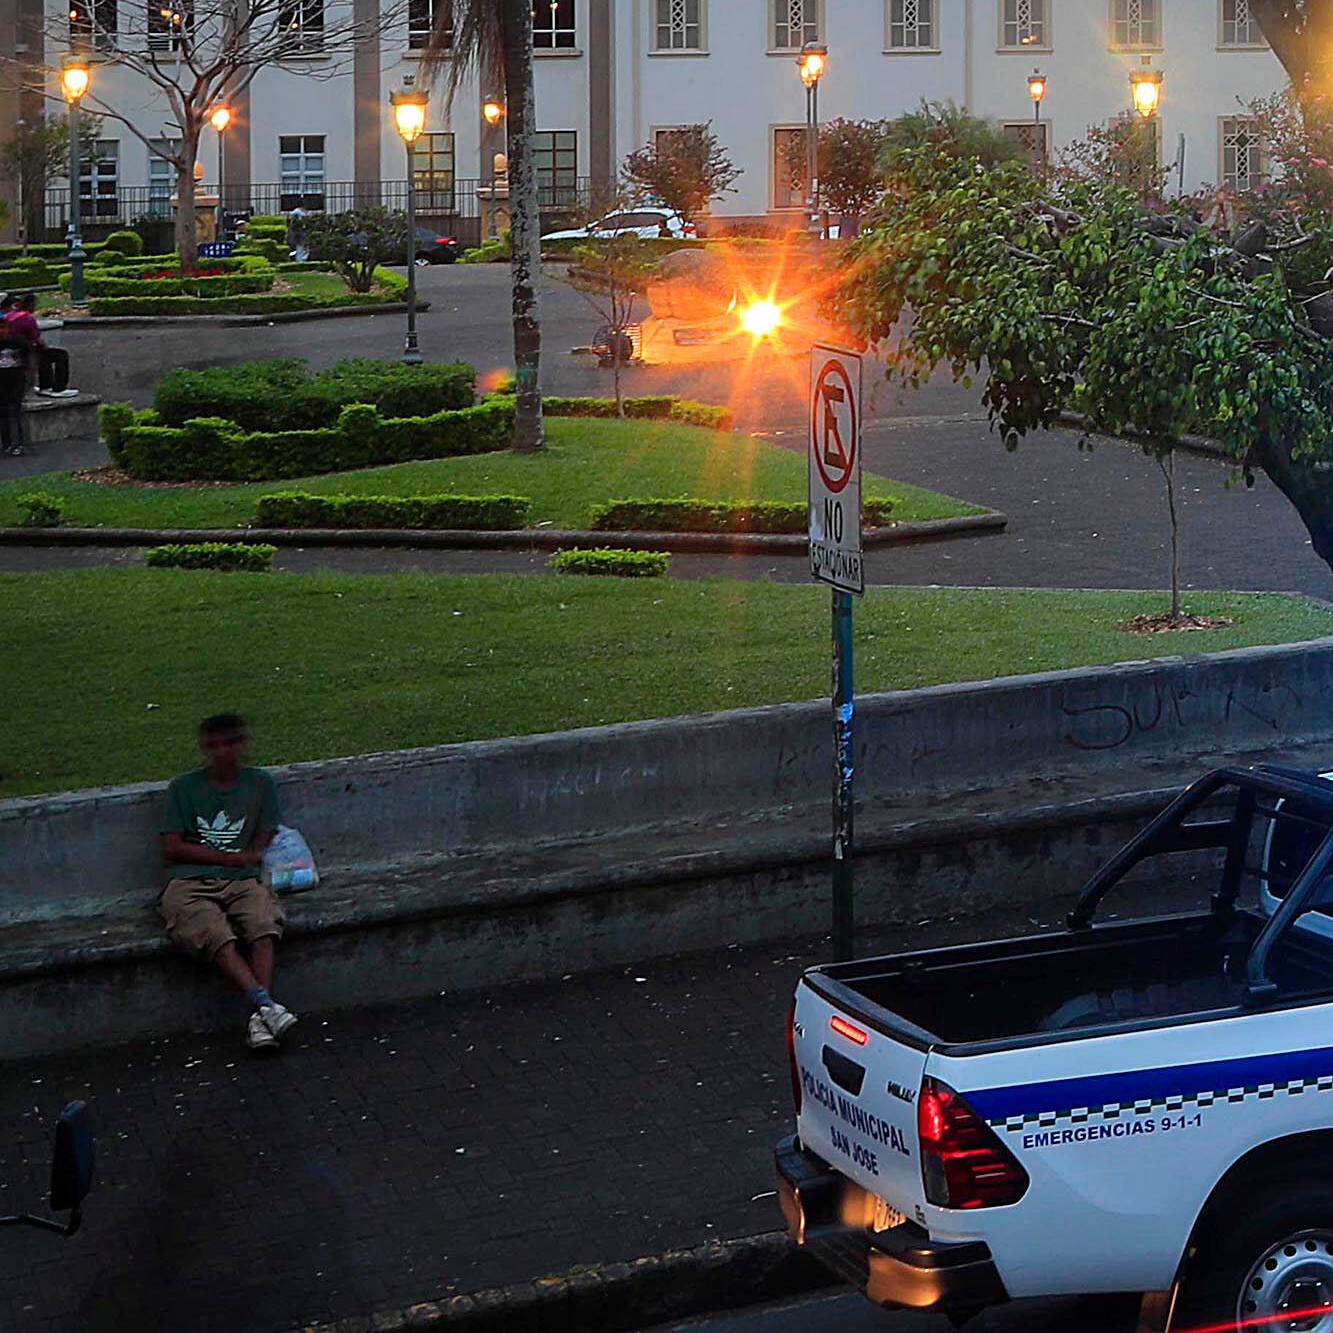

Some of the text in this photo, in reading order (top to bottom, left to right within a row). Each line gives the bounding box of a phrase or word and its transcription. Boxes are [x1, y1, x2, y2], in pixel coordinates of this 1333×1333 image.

[825, 497, 843, 544] NO
[801, 1066, 911, 1156] POLICIA MUNICIPAL
[1023, 1113, 1203, 1149] EMERGENCIAS 9-1-1
[830, 1126, 880, 1176] SAN JOSE
